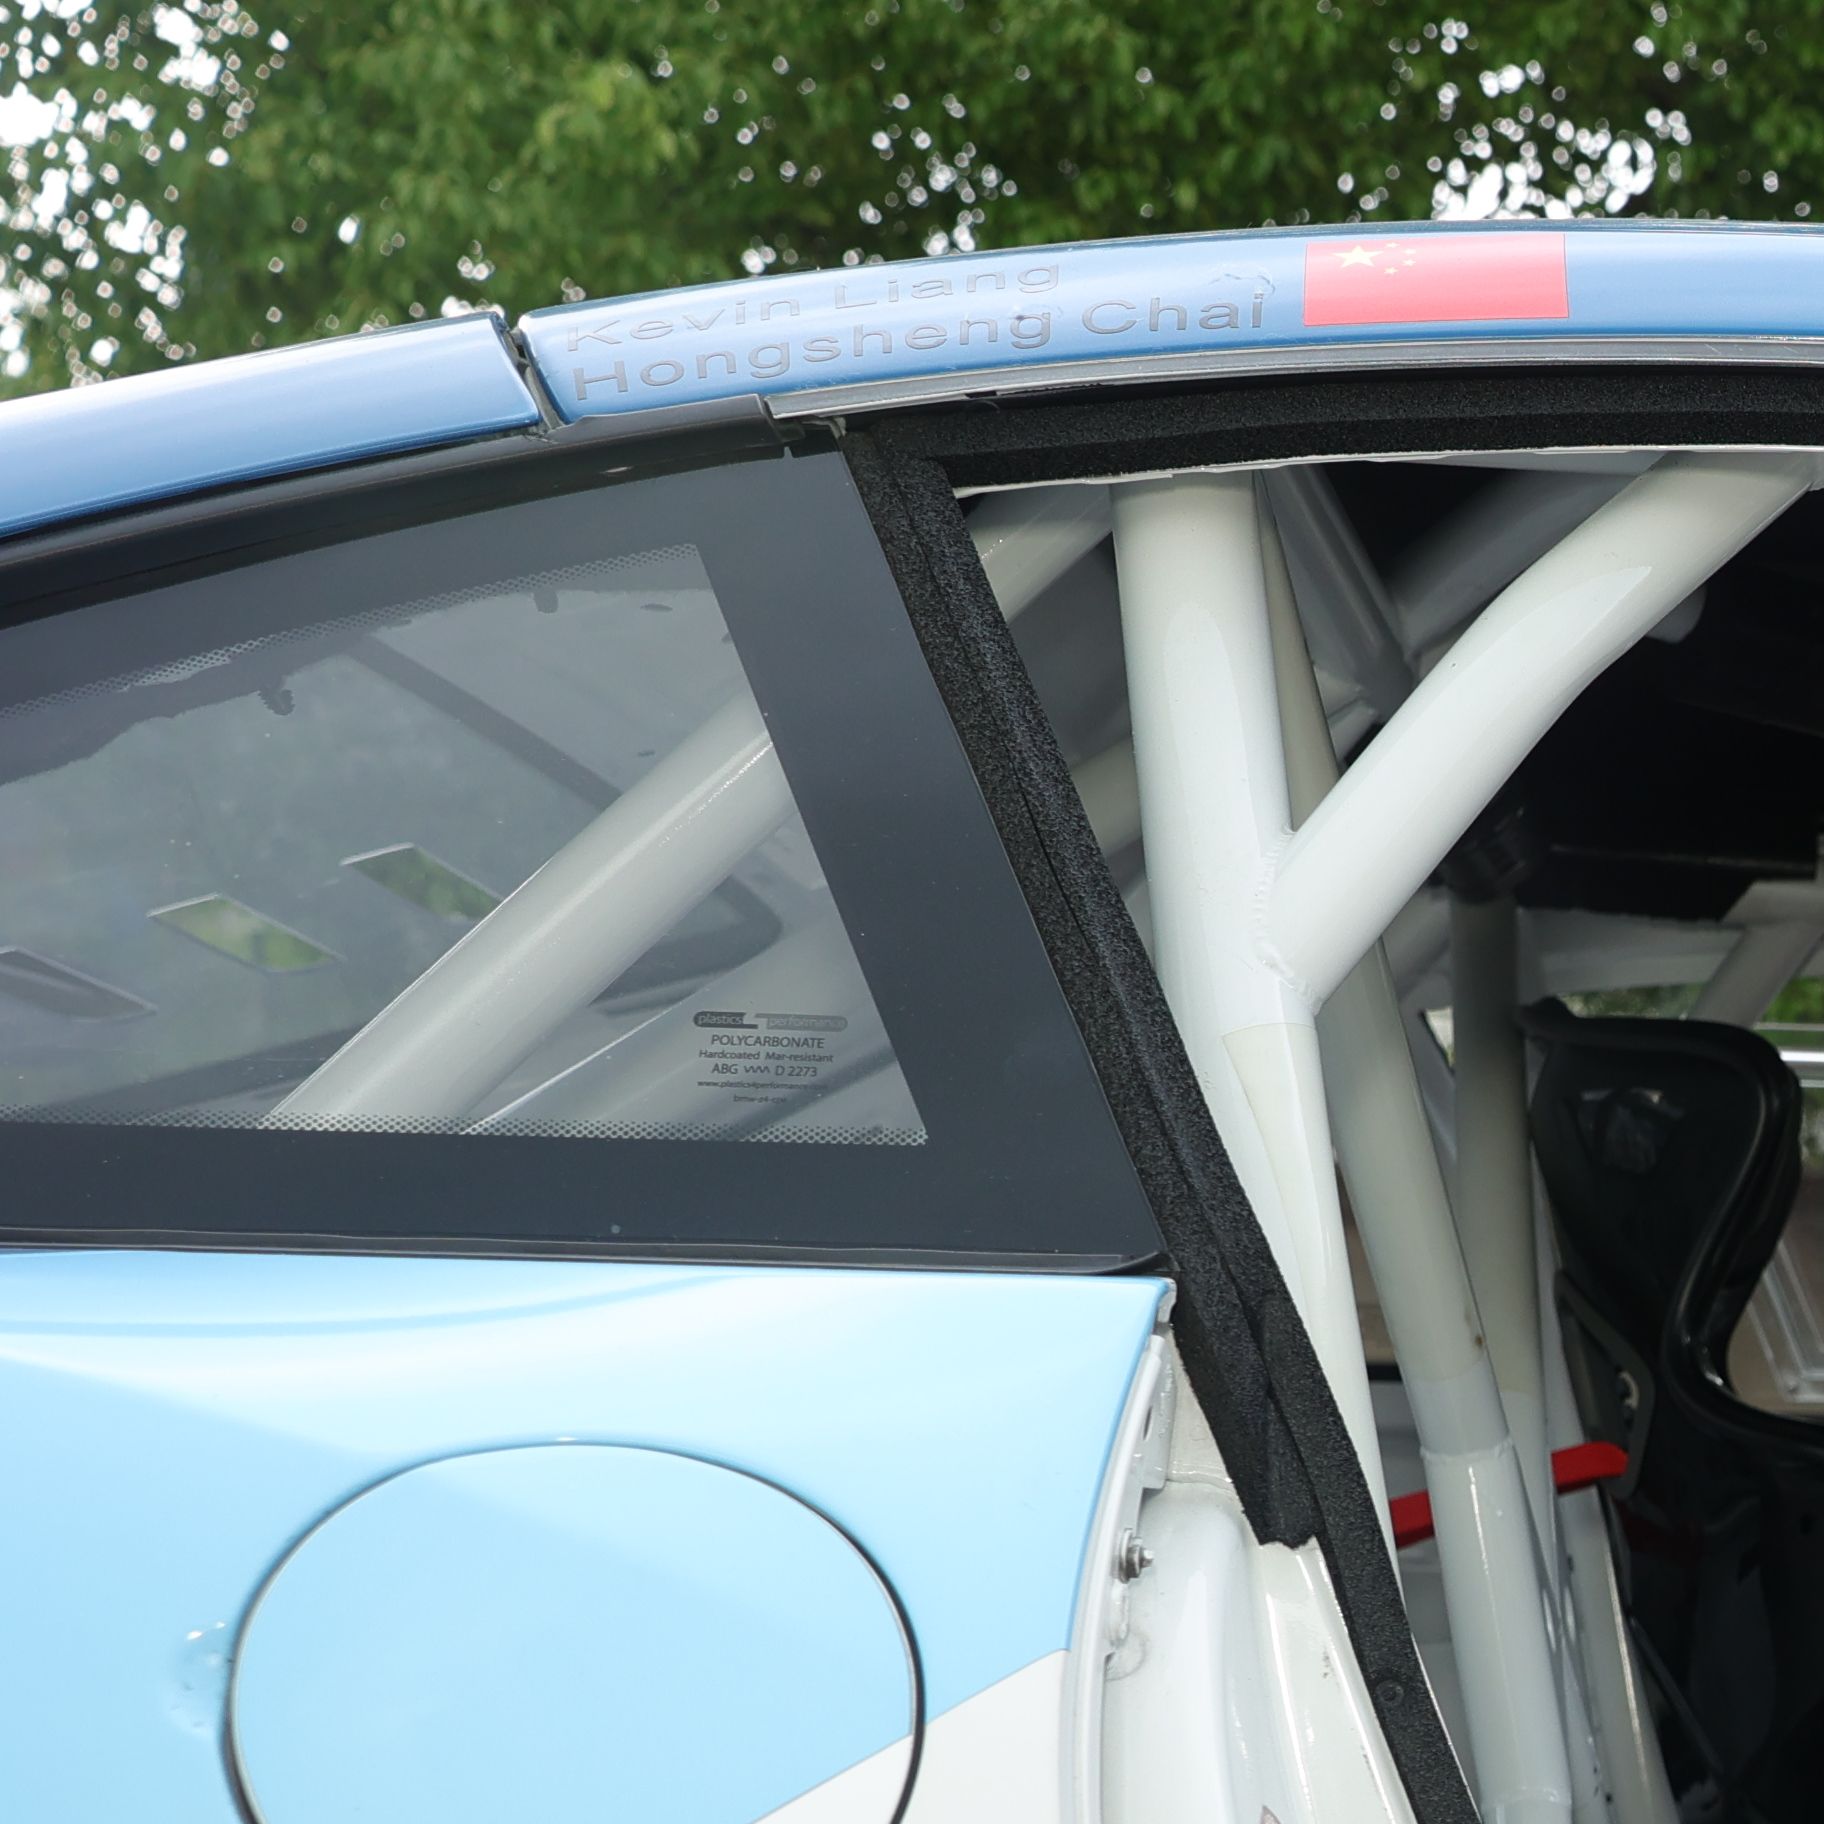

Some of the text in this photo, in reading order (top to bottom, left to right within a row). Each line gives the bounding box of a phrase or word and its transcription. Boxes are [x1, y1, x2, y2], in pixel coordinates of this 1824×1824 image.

[566, 264, 1059, 351] Kevin Liang
[572, 292, 1264, 401] Hongsheng Chai
[698, 1012, 744, 1026] plastics
[710, 1034, 826, 1049] POLYCARBONATE
[699, 1050, 834, 1062] Hardcoated Mar-resistant
[711, 1063, 818, 1077] ABG D 2273
